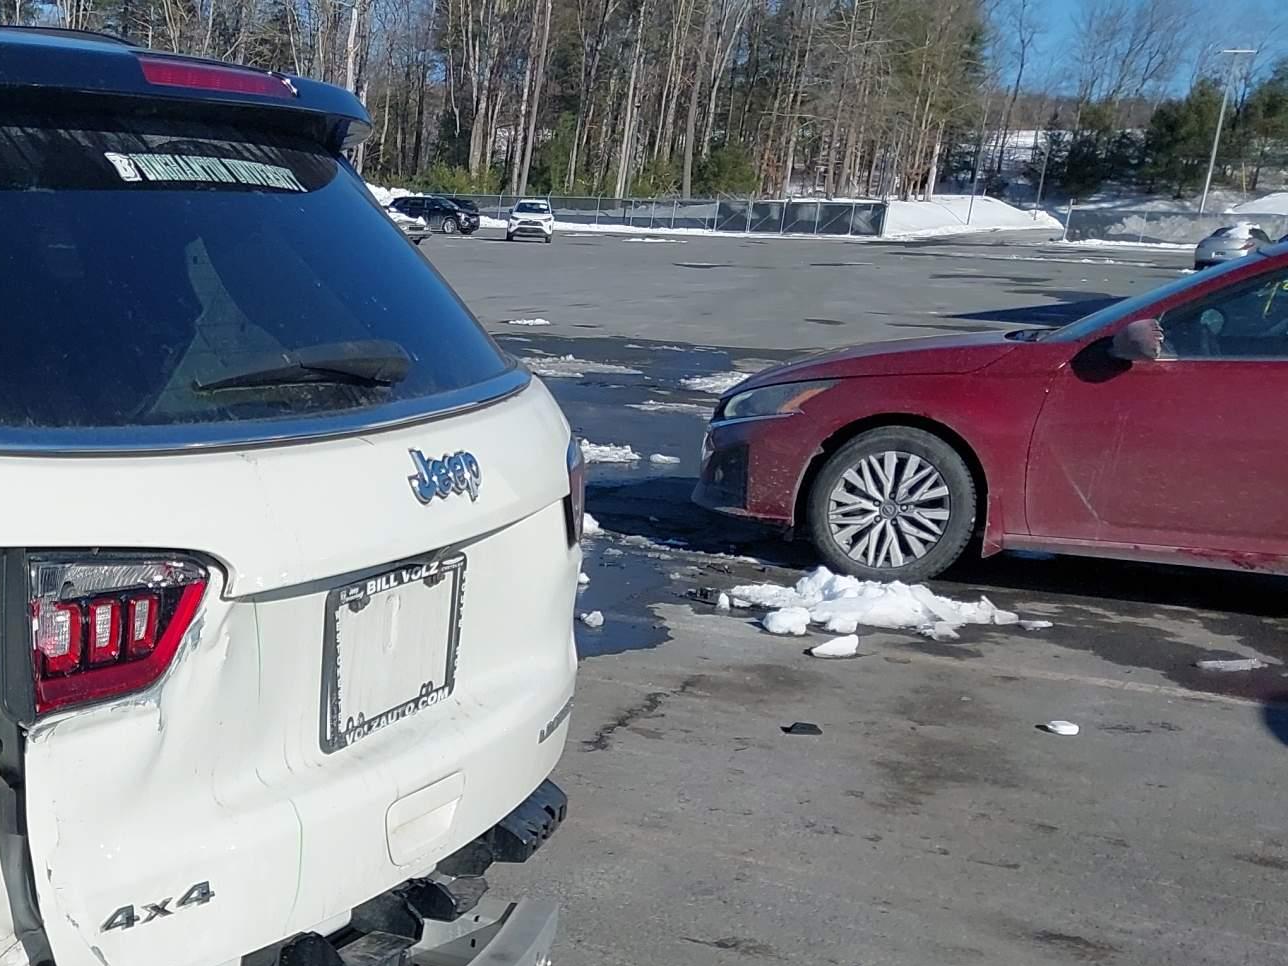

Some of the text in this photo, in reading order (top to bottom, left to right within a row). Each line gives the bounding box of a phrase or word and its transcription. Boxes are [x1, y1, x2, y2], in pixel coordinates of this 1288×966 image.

[129, 153, 237, 184] BINGHAMTON
[220, 158, 309, 193] UNIVERSITY
[407, 447, 481, 506] Jeep
[365, 561, 440, 595] BILL VOLZ
